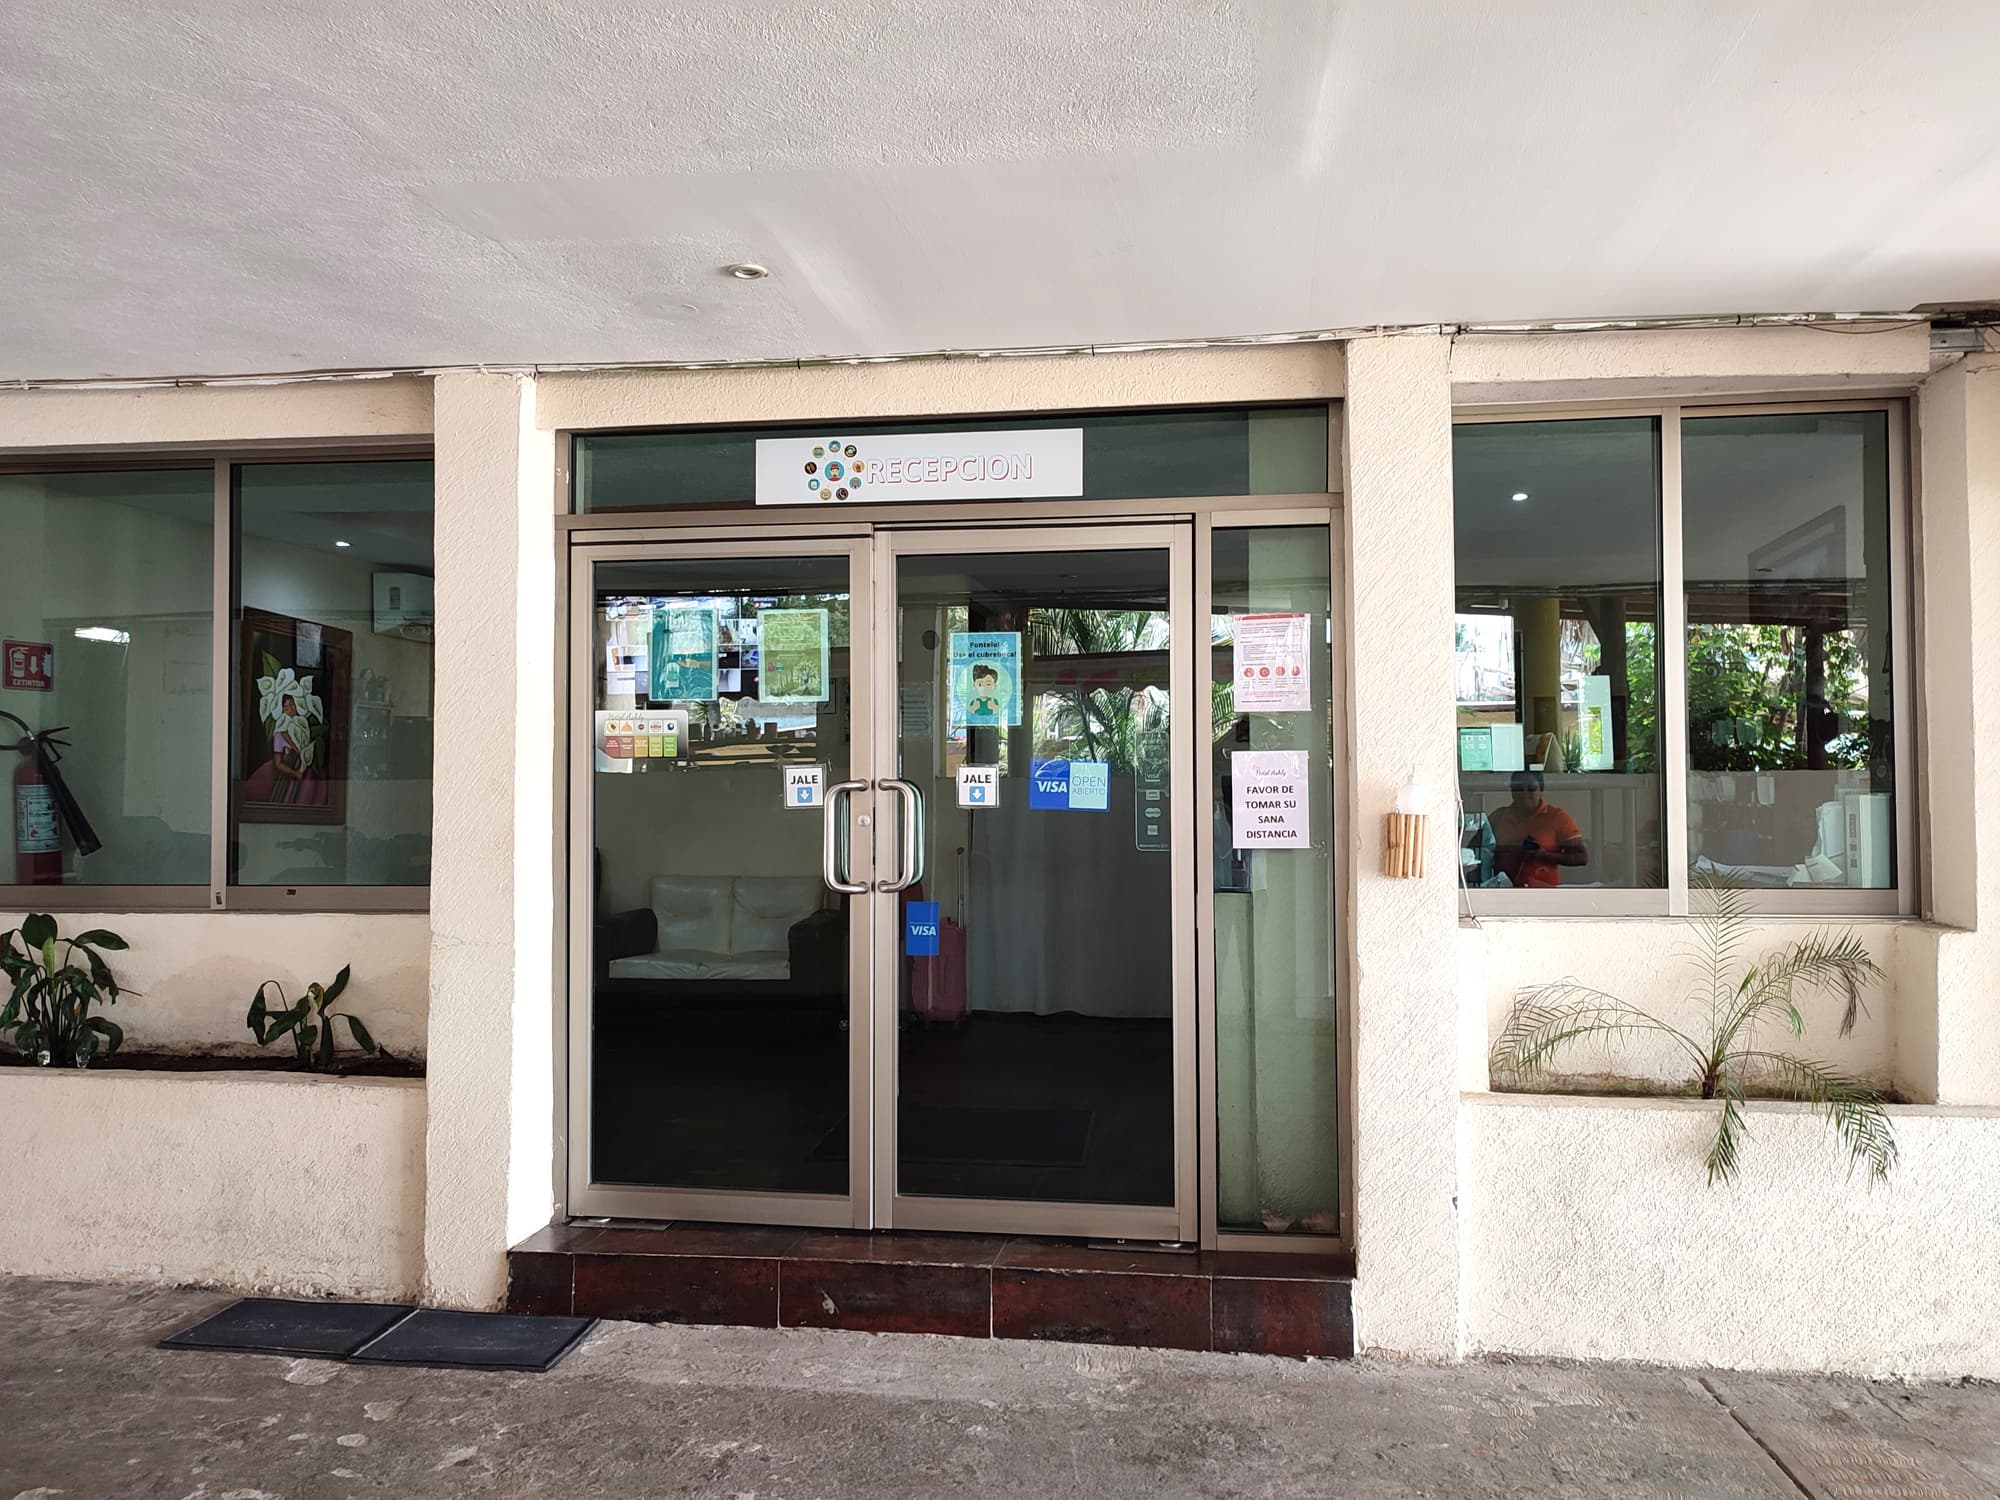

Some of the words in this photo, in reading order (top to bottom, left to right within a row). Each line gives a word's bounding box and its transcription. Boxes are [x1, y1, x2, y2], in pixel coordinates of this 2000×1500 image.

[867, 454, 1033, 484] RECEPCION
[968, 650, 975, 658] el
[790, 774, 819, 785] JALE
[963, 773, 992, 784] JALE
[1072, 775, 1106, 787] OPEN
[1035, 780, 1067, 793] VISA
[1072, 787, 1106, 796] ABIERTO
[1246, 785, 1279, 794] FAVOR
[1281, 785, 1294, 794] DE
[1245, 801, 1281, 809] TOMAR
[1283, 800, 1296, 809] SU
[1258, 815, 1285, 824] SANA
[1246, 830, 1298, 839] DISTANCIA
[909, 925, 937, 936] VISA
